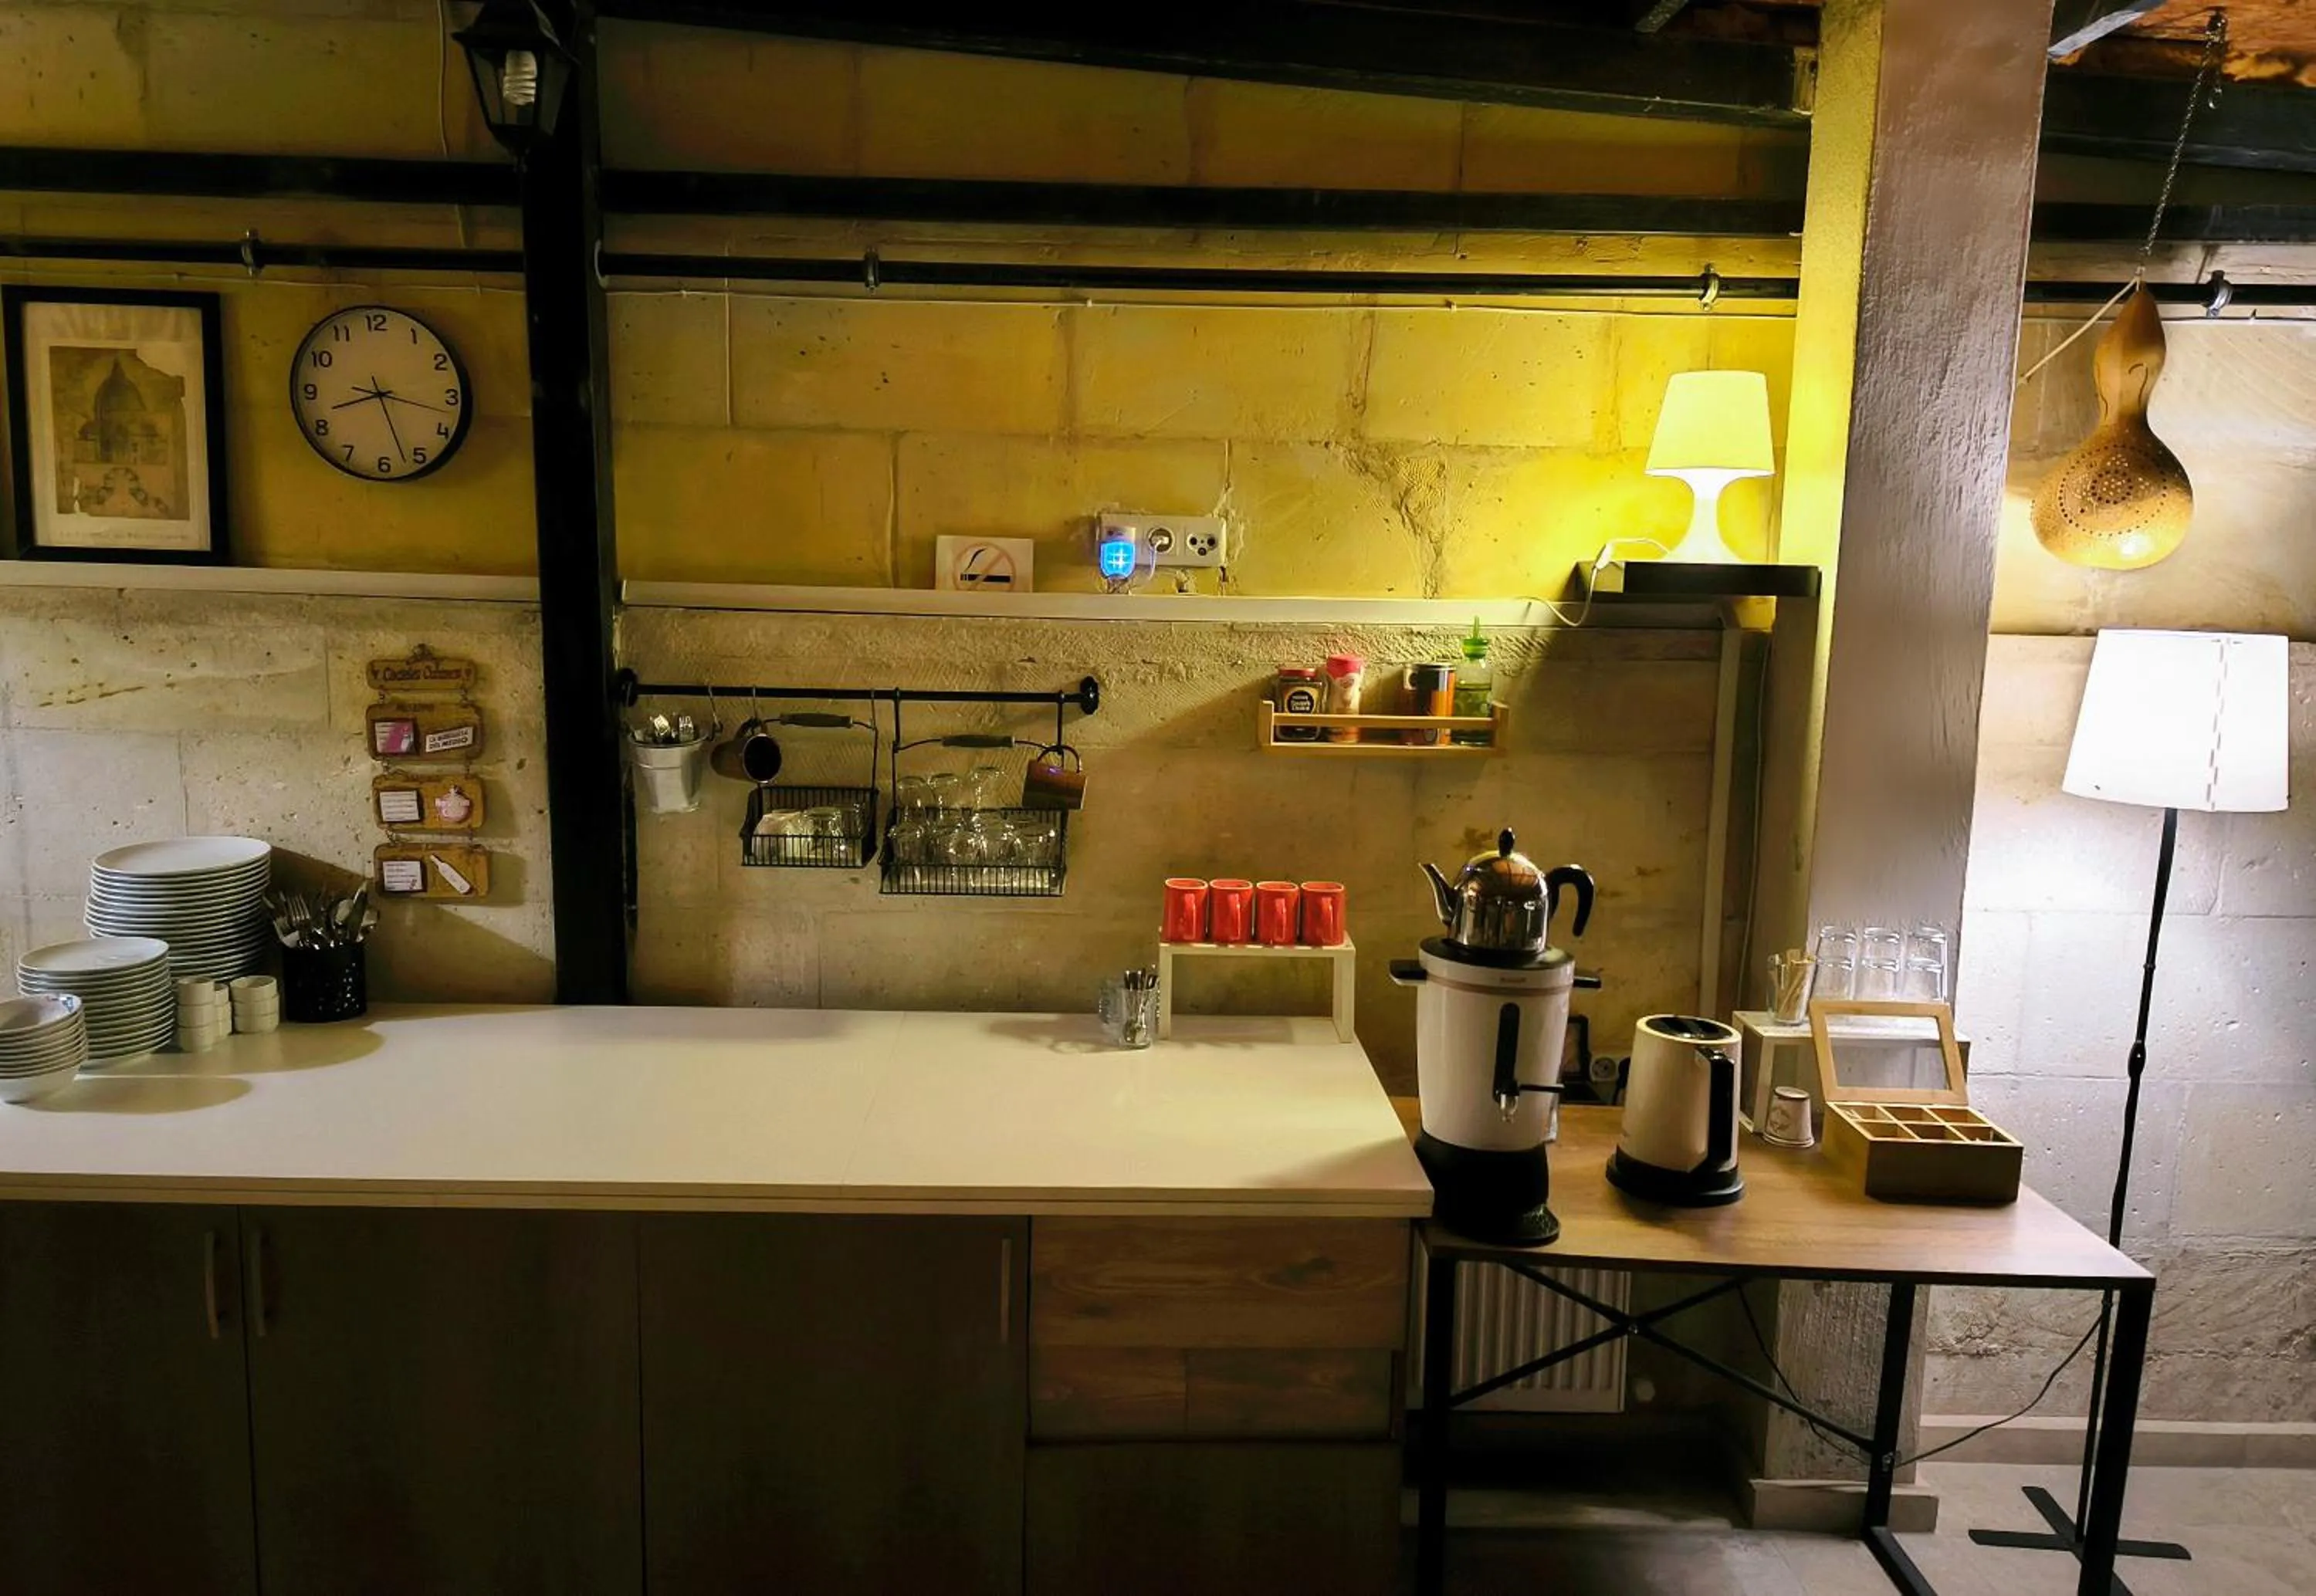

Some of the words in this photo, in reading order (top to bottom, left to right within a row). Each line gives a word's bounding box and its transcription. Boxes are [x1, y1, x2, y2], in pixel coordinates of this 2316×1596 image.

[364, 313, 388, 332] 12
[333, 324, 350, 342] 11
[410, 326, 418, 345] 1
[310, 350, 333, 368] 10
[433, 353, 448, 371] 2
[303, 383, 317, 401] 9
[445, 387, 459, 407] 3
[315, 418, 329, 437] 8
[436, 422, 449, 441] 4
[341, 443, 355, 462] 7
[412, 447, 427, 464] 5
[378, 455, 391, 474] 6
